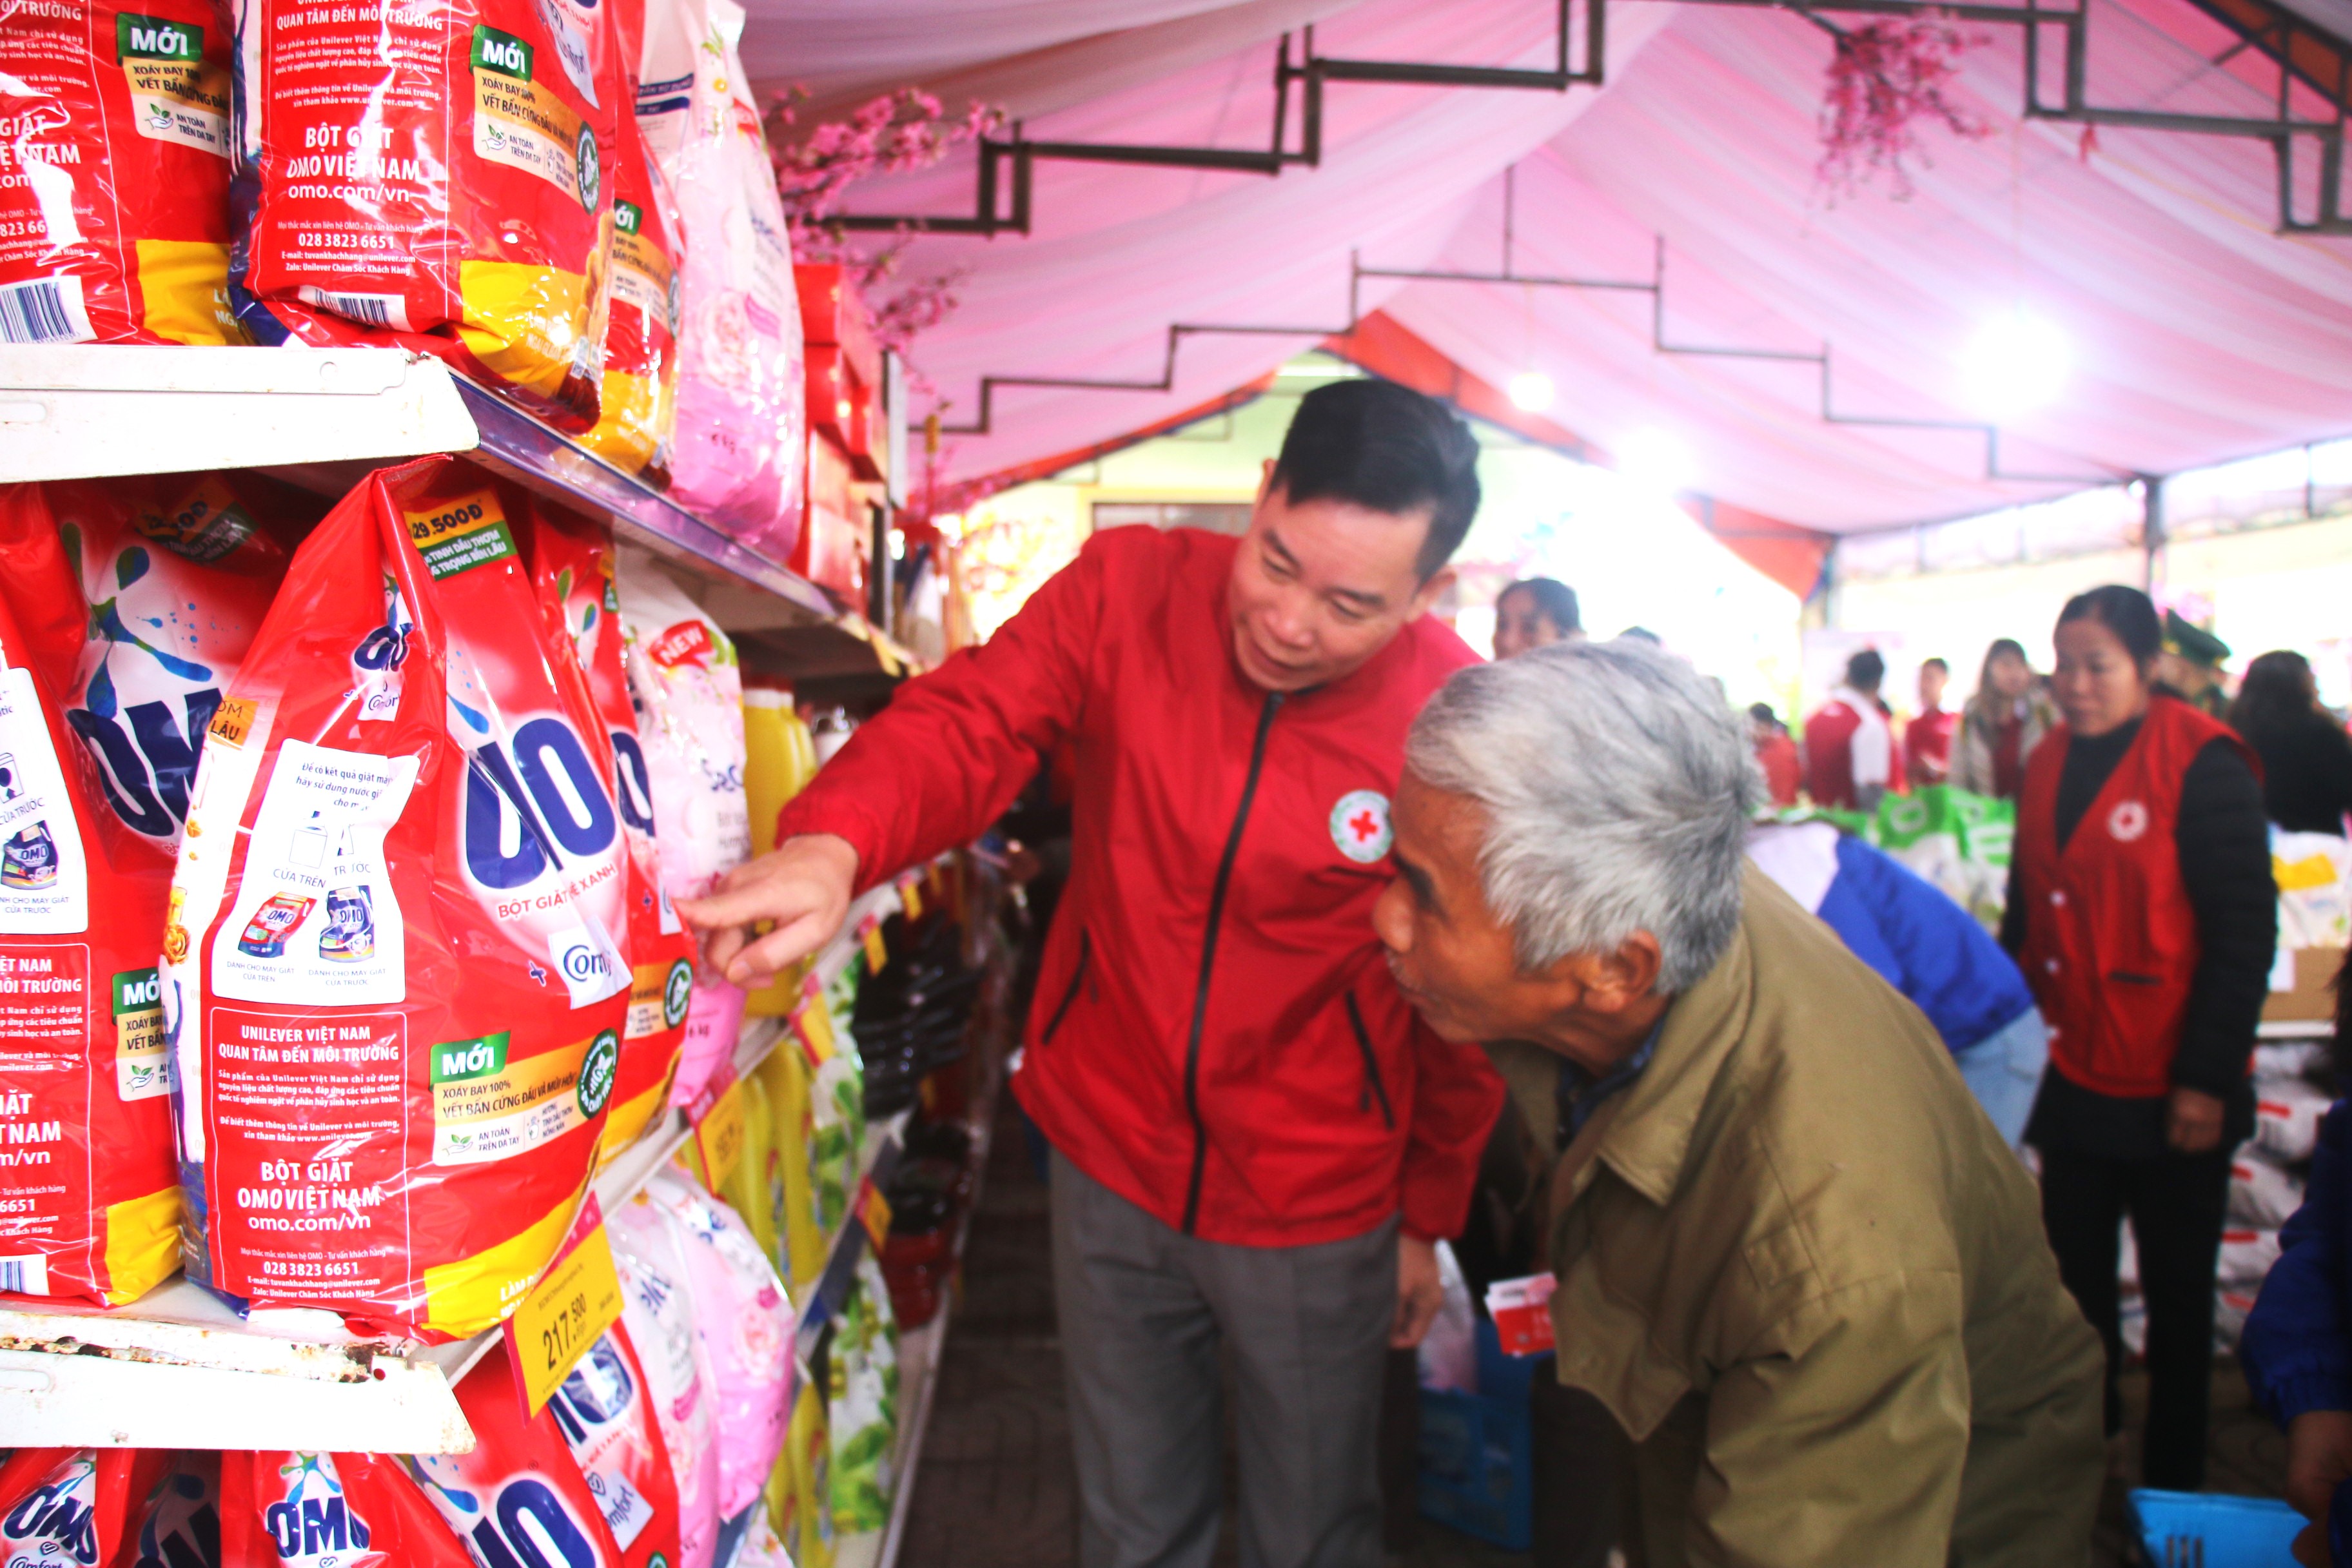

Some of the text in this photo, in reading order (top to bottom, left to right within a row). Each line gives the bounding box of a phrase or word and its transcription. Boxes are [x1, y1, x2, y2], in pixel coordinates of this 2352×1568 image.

[19, 1, 82, 21] TRƯỜNG
[277, 12, 304, 30] QUAN
[306, 9, 329, 24] TÂM
[332, 5, 356, 23] ĐẾN
[387, 9, 443, 31] TRƯỜNG
[6, 28, 83, 45] Nam dụng
[131, 26, 188, 56] MỚI
[320, 35, 370, 45] Unilever Việt
[483, 39, 525, 74] MỚI
[133, 64, 161, 75] XOÁY
[164, 66, 183, 75] BAY
[137, 77, 161, 90] VẾT
[482, 77, 503, 91] XOÁY
[505, 84, 520, 97] BAY
[483, 93, 499, 108] VẾT
[306, 122, 341, 152] BỘT
[371, 157, 420, 181] NAM
[288, 184, 409, 202] omo.com/vn
[614, 205, 634, 230] ỚI
[299, 233, 394, 249] 028 3823 6651
[304, 251, 416, 263] tuvankhachhang@unilever.com
[303, 263, 331, 272] Unilever
[367, 263, 390, 274] Khách
[391, 266, 410, 276] Hàng
[429, 545, 455, 561] TINH
[487, 542, 507, 556] LÂU
[659, 626, 705, 665] NEW
[210, 720, 240, 740] LÂU
[340, 769, 356, 779] quả
[358, 772, 375, 784] giặt
[296, 776, 369, 797] hãy dụng nước
[333, 798, 348, 807] cho
[21, 845, 48, 861] OMO
[299, 873, 326, 888] TRÊN
[498, 897, 531, 919] BỘT
[536, 888, 568, 909] GIẶT
[580, 863, 616, 892] XANH
[268, 910, 294, 923] OMO
[19, 958, 52, 972] NAM
[22, 977, 82, 994] TRƯỜNG
[59, 1006, 82, 1015] dụng
[126, 1016, 148, 1032] XOÁY
[126, 1034, 146, 1050] VẾT
[241, 1024, 371, 1044] UNILEVER VIỆT NAM
[219, 1043, 399, 1063] QUAN TÂM ĐẾN MÔI TRƯỜNG
[442, 1042, 495, 1076] MỚI
[232, 1072, 400, 1084] phẩm của Unilever Việt Nam chỉ dụng
[258, 1083, 274, 1093] chất
[275, 1084, 297, 1095] lượng
[377, 1081, 400, 1093] chuẩn
[443, 1079, 511, 1099] XOÁY BAY 100%
[295, 1097, 314, 1107] phân
[329, 1097, 345, 1106] sinh
[443, 1101, 463, 1119] VẾT
[466, 1097, 490, 1116] BẨN
[493, 1094, 520, 1112] CỨNG
[9, 1121, 61, 1144] NAM
[309, 1121, 342, 1132] Unilever
[355, 1121, 369, 1129] môi
[478, 1127, 510, 1141] AN TOÀN
[257, 1132, 295, 1142] tham khảo
[478, 1136, 520, 1152] TRÊN DA TAY
[260, 1157, 353, 1188] BỘT GIẶT
[237, 1185, 380, 1215] OMO VIỆT NAM
[248, 1212, 371, 1231] omo.com/vn
[349, 1249, 369, 1259] khách
[369, 1248, 386, 1259] hàng
[264, 1261, 358, 1277] 028 3823 6651
[271, 1278, 380, 1289] tuvankhachhang@unilever.com
[253, 1287, 375, 1299] Zalo: Unilever Chăm Sóc Khách Hàng
[605, 1484, 634, 1529] omfort
